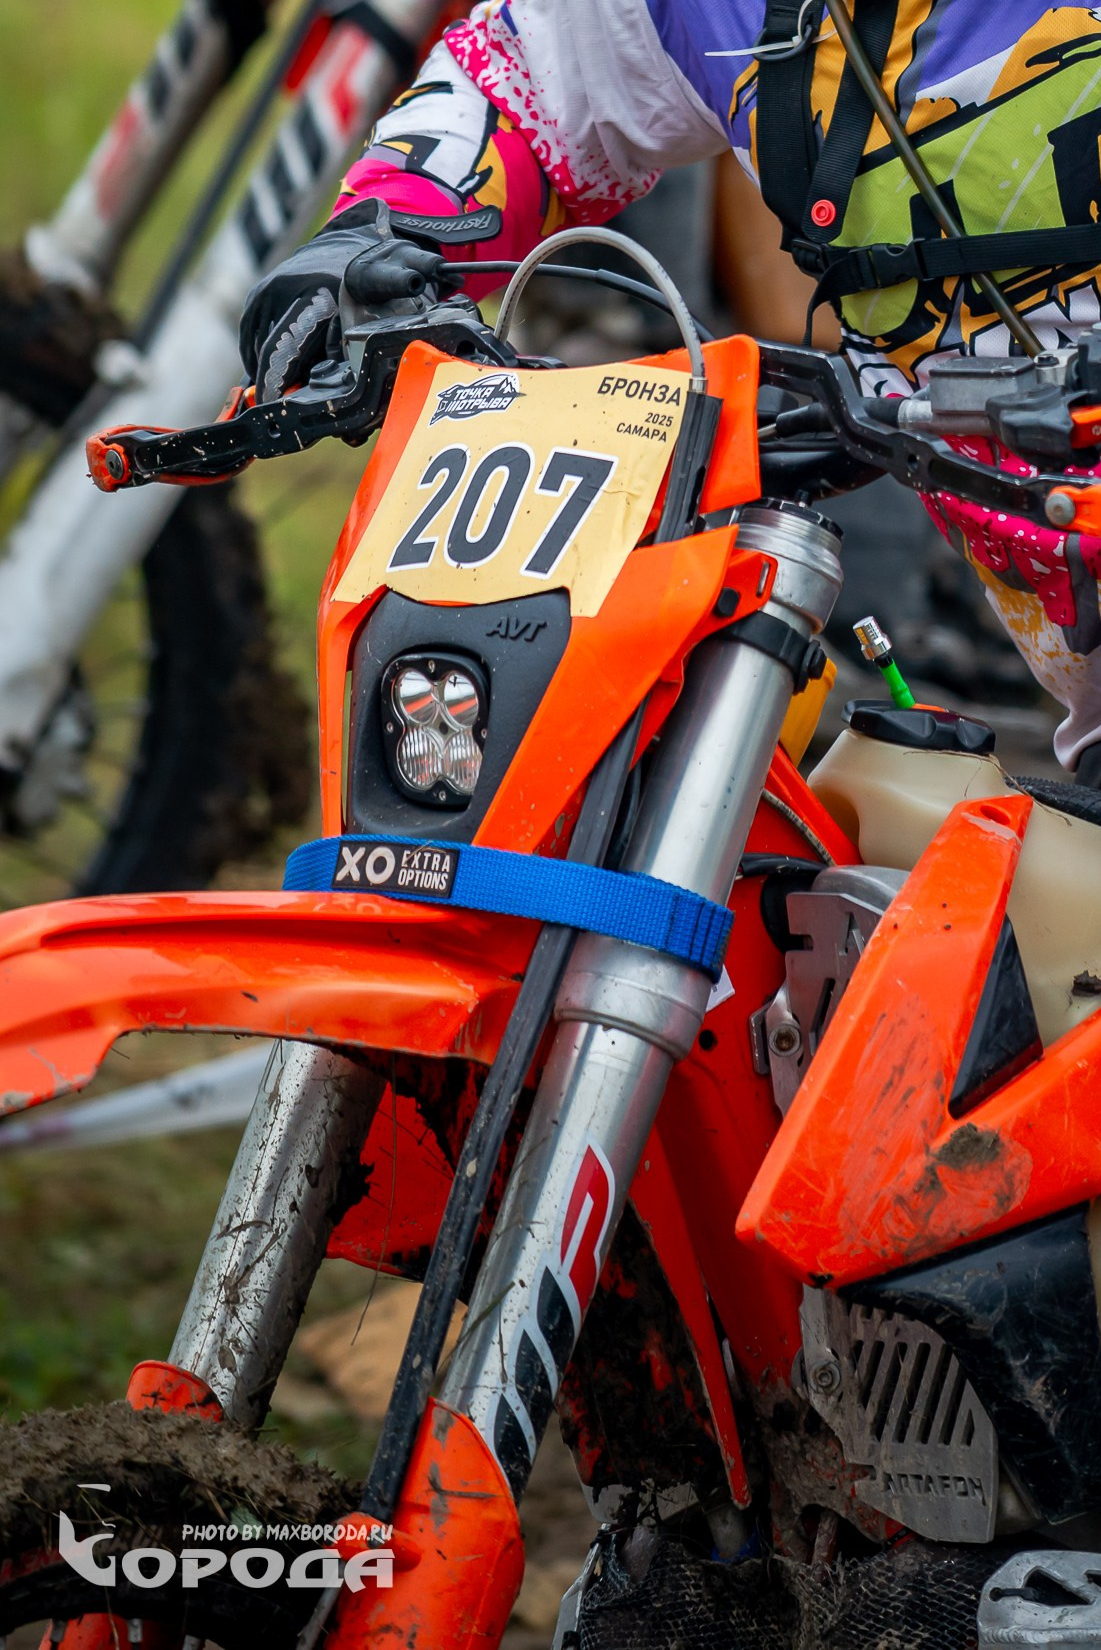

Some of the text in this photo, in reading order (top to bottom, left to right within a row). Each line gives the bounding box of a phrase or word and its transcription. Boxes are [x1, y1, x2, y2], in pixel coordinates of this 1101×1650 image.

[397, 213, 492, 232] FASTHOUSE
[454, 386, 495, 400] ТОЧКА
[597, 376, 681, 406] БРОНЗА
[645, 412, 674, 427] 2025
[616, 422, 667, 442] САМАРА
[387, 443, 618, 578] 207
[335, 846, 395, 884] XO
[402, 850, 450, 872] EXTRA
[398, 868, 449, 890] OPTIONS
